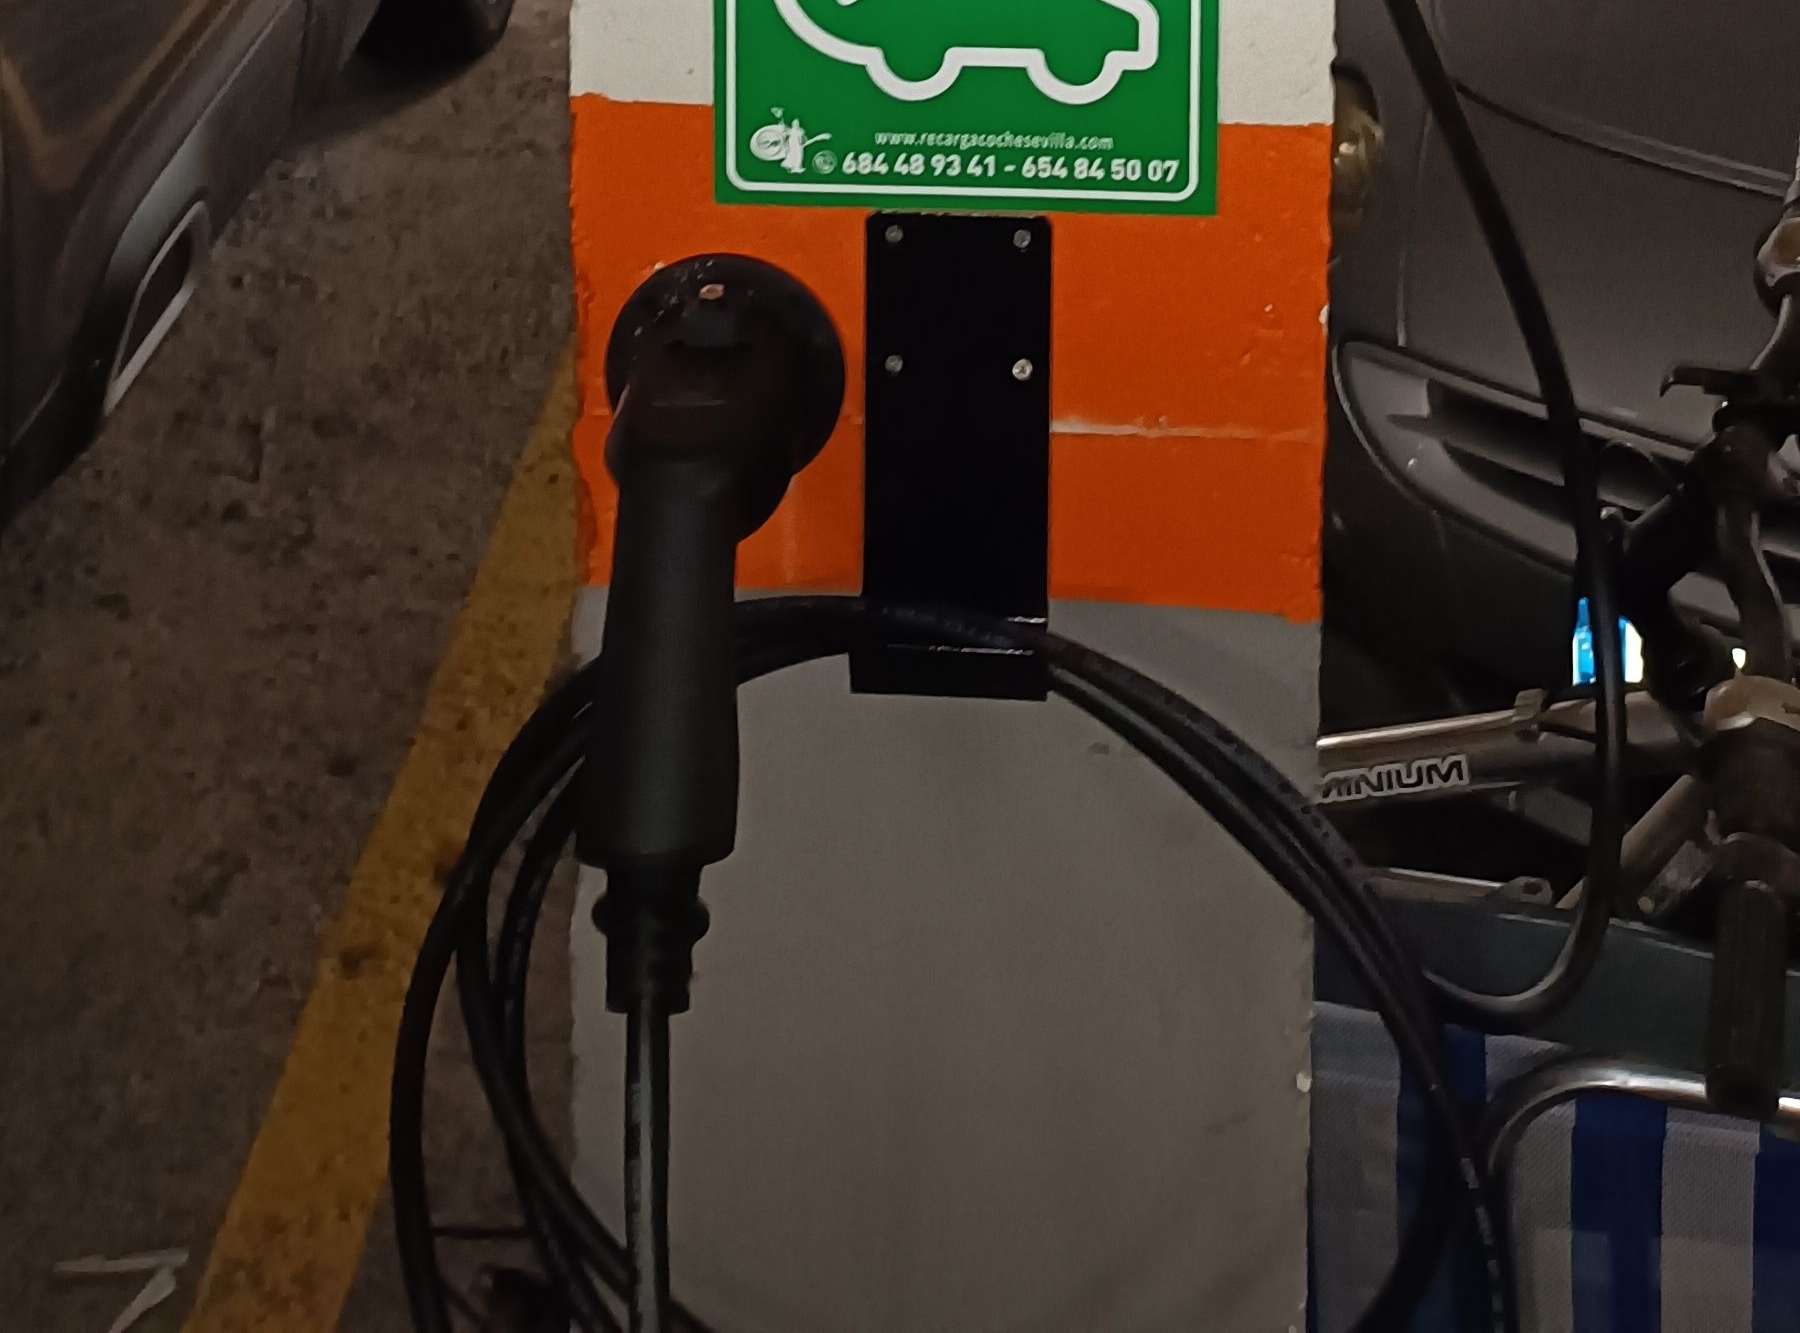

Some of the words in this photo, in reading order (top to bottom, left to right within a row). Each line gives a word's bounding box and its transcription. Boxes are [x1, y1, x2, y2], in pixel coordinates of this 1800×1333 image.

[874, 129, 1115, 151] www.recargacochesevilla.com
[841, 151, 889, 175] 684
[893, 152, 926, 176] 48
[930, 153, 962, 177] 93
[966, 154, 996, 178] 41
[1021, 155, 1069, 180] 654
[1073, 156, 1106, 181] 84
[1110, 157, 1143, 182] 50
[1147, 158, 1180, 183] 07
